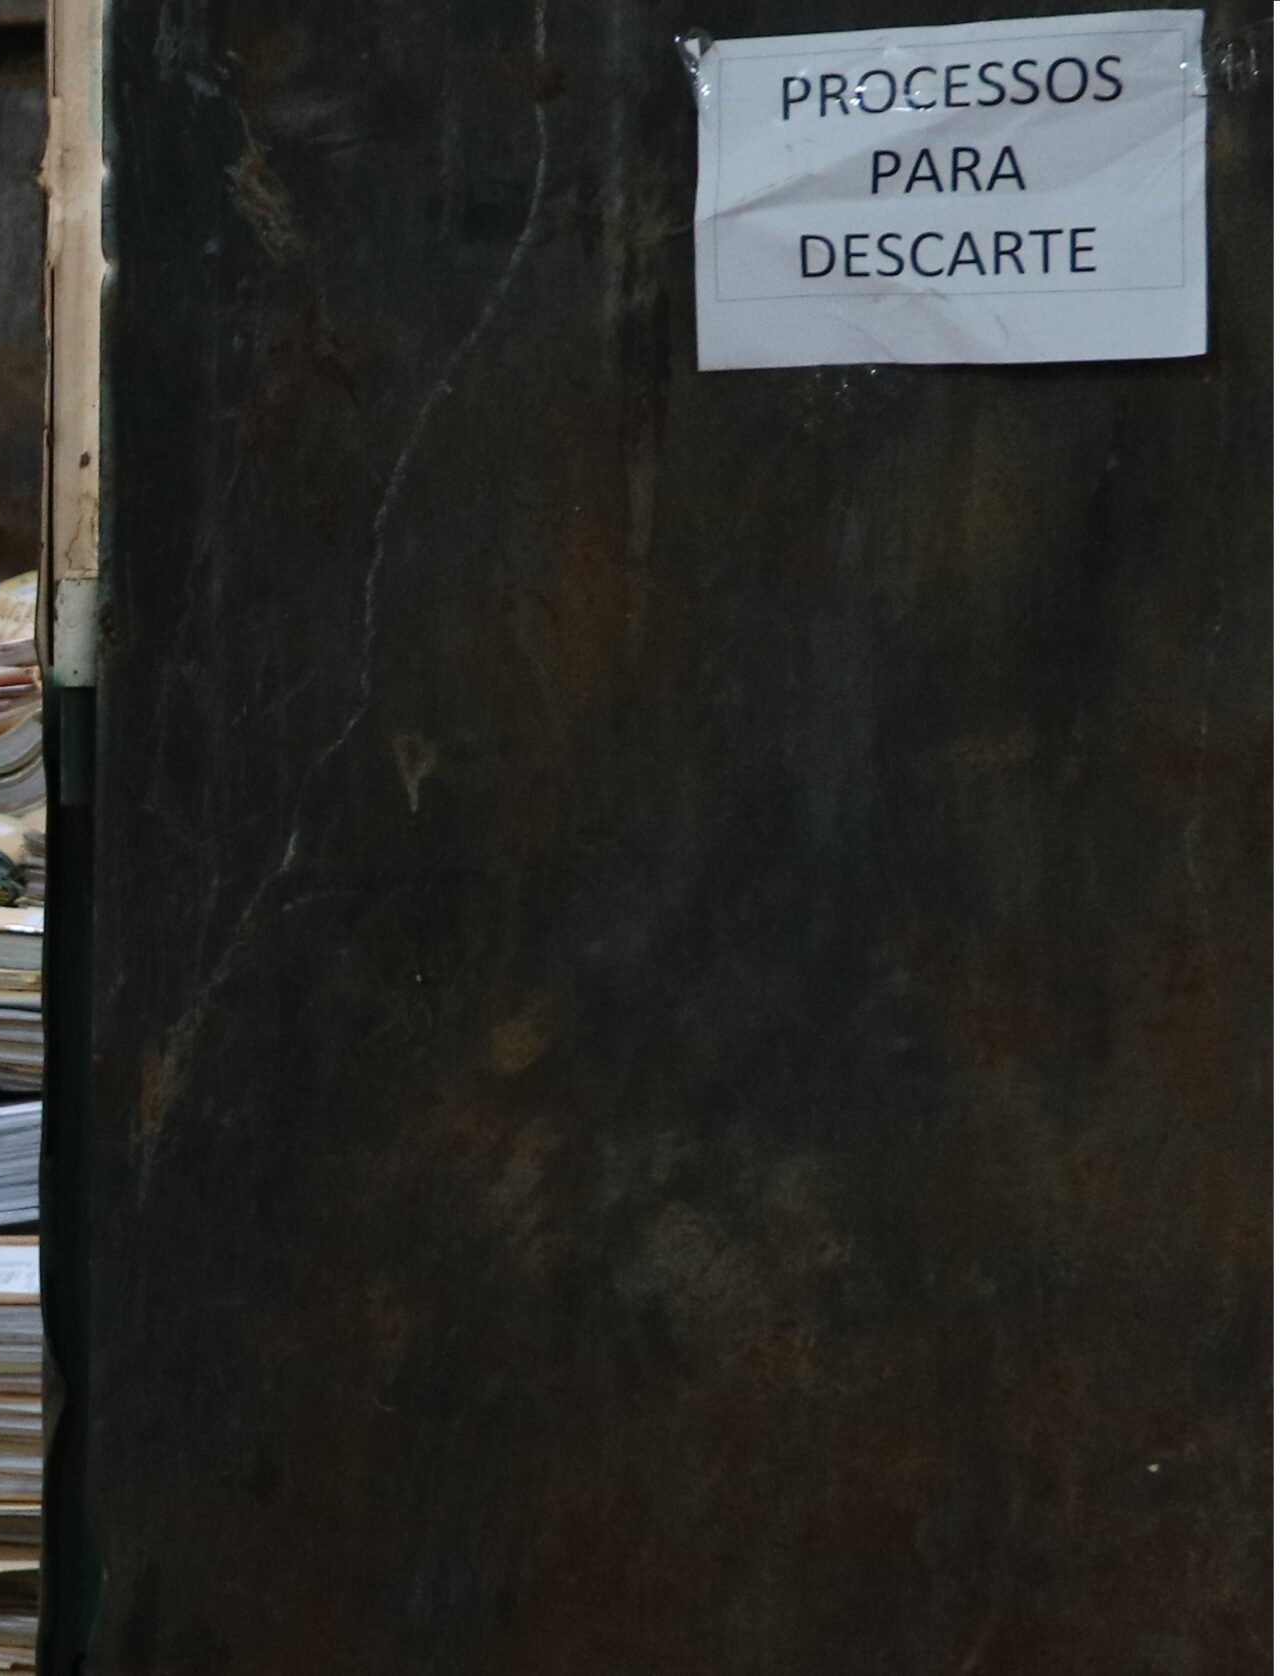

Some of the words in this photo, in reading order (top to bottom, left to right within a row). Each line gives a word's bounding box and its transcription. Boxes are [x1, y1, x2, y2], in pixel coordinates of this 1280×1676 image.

[782, 55, 1124, 121] PROCESSOS
[871, 145, 1027, 195] PARA
[800, 227, 1097, 279] DESCARTE
